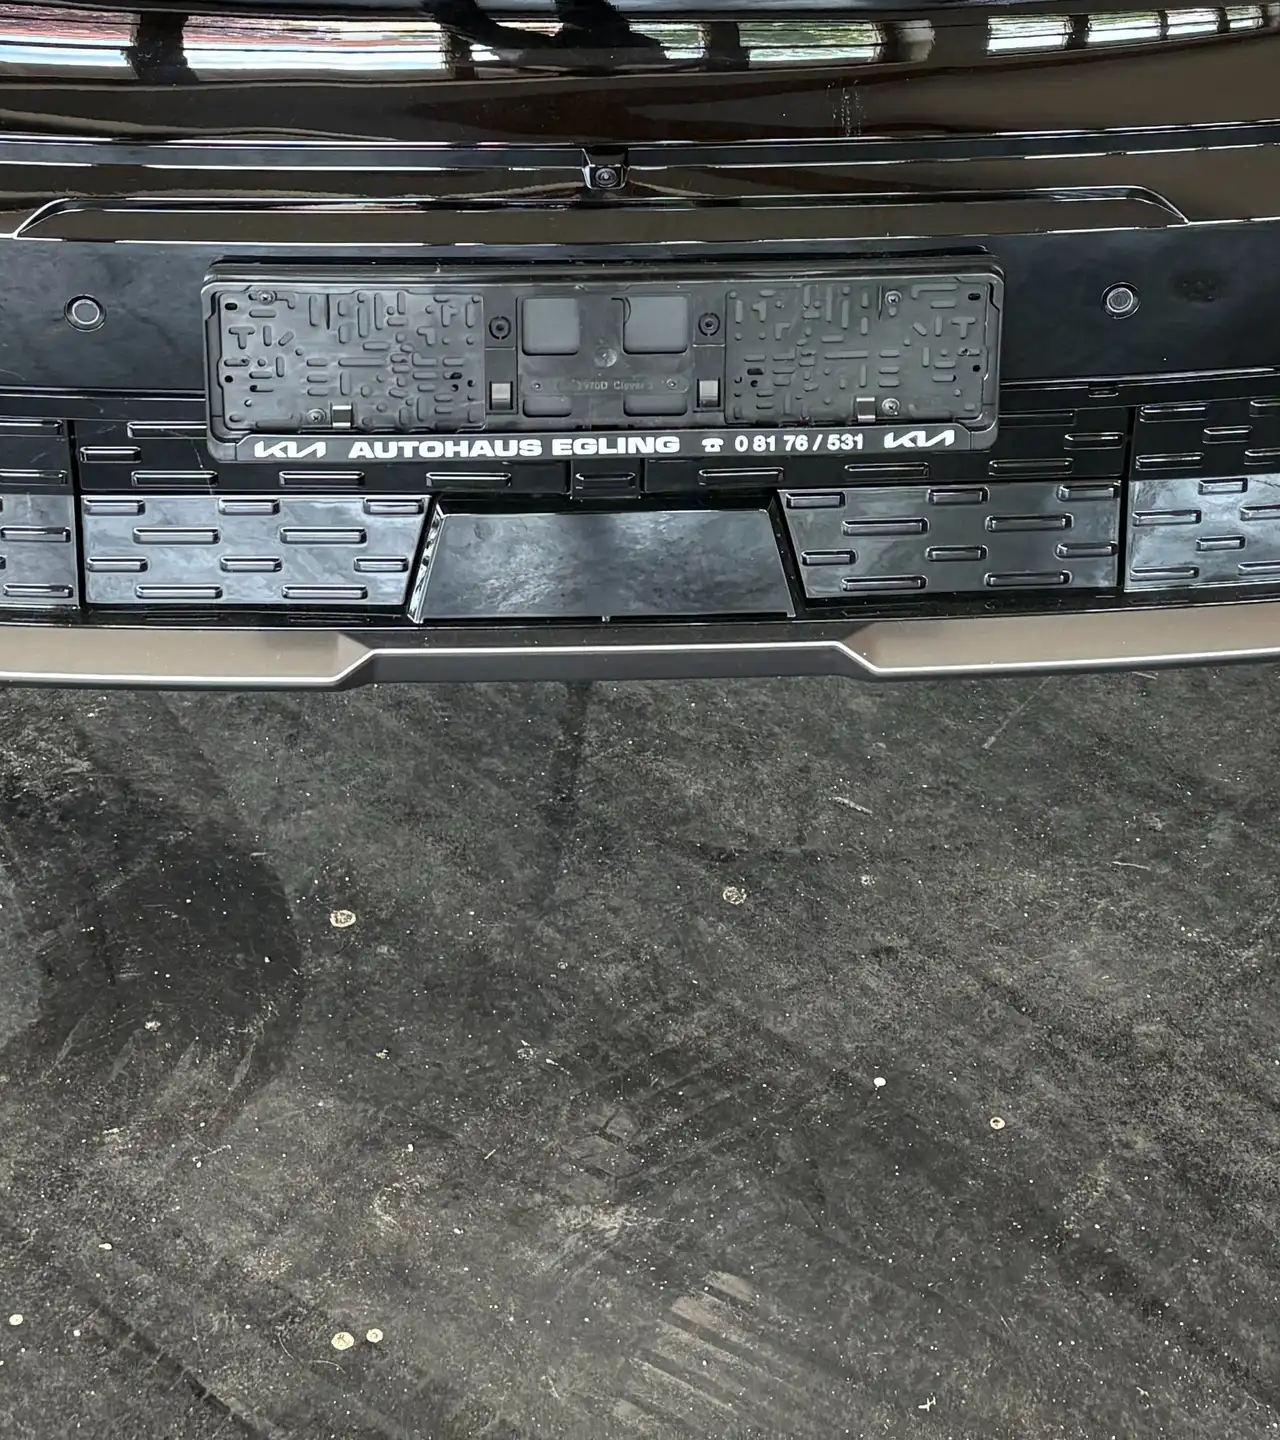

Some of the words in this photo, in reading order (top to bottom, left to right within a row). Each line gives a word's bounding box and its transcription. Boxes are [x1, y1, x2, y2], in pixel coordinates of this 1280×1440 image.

[254, 440, 327, 459] KIA
[348, 439, 542, 458] AUTOHAUS
[552, 436, 681, 456] EGLING
[753, 434, 776, 451] 81
[784, 434, 809, 451] 76
[827, 433, 864, 451] 531
[883, 429, 955, 449] KIA
